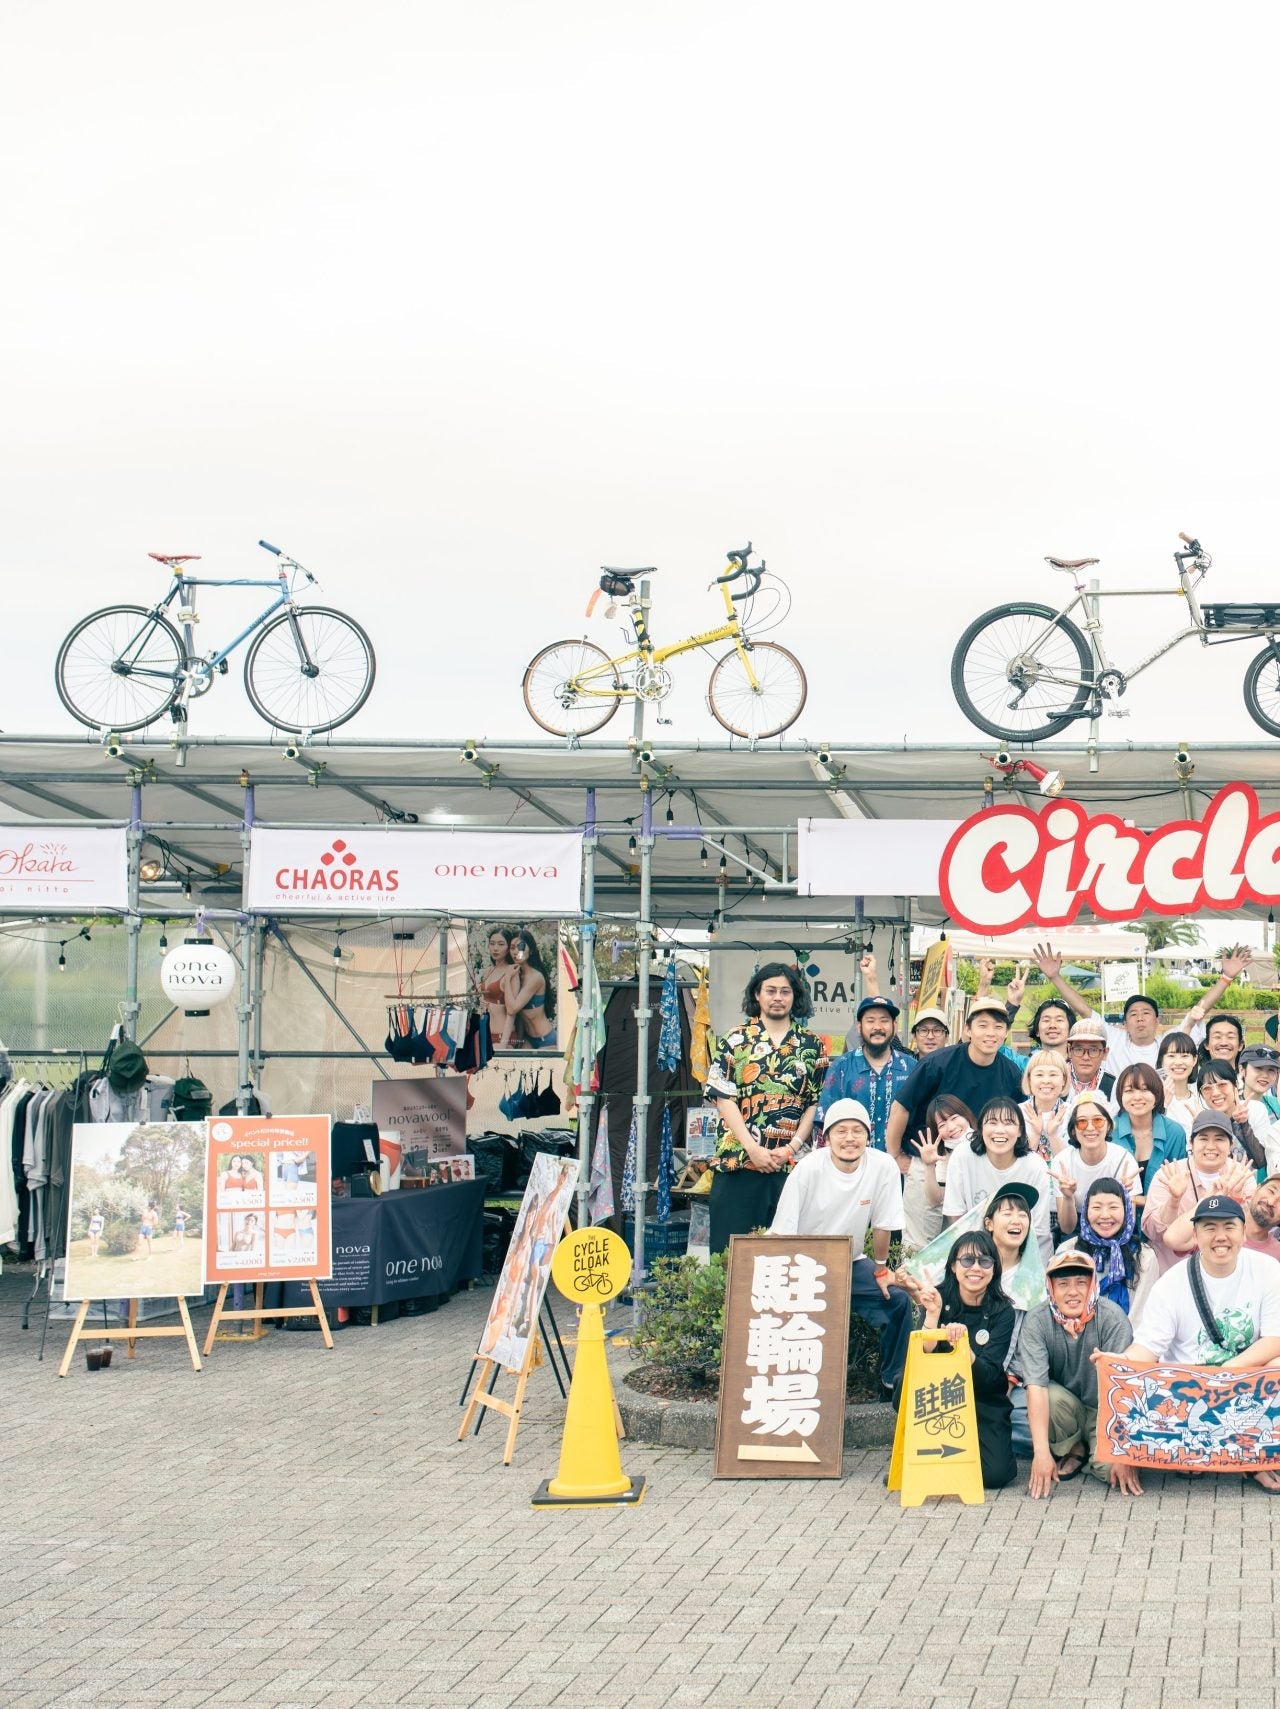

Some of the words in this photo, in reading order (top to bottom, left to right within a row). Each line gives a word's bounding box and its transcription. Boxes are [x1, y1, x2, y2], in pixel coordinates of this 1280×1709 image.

[434, 864, 485, 877] one
[493, 865, 558, 878] nova
[275, 868, 399, 891] CHAORAS
[27, 885, 69, 893] nitto
[275, 893, 320, 901] cheerful
[173, 962, 218, 971] one
[169, 975, 222, 985] nova
[388, 1109, 451, 1125] novawool
[231, 1138, 269, 1149] special
[336, 1245, 371, 1254] nova
[574, 1238, 609, 1257] CYCLE
[386, 1259, 418, 1276] one
[574, 1252, 610, 1272] CLOAK
[741, 1254, 827, 1437] 駐輪場
[914, 1372, 967, 1419] 駐輪
